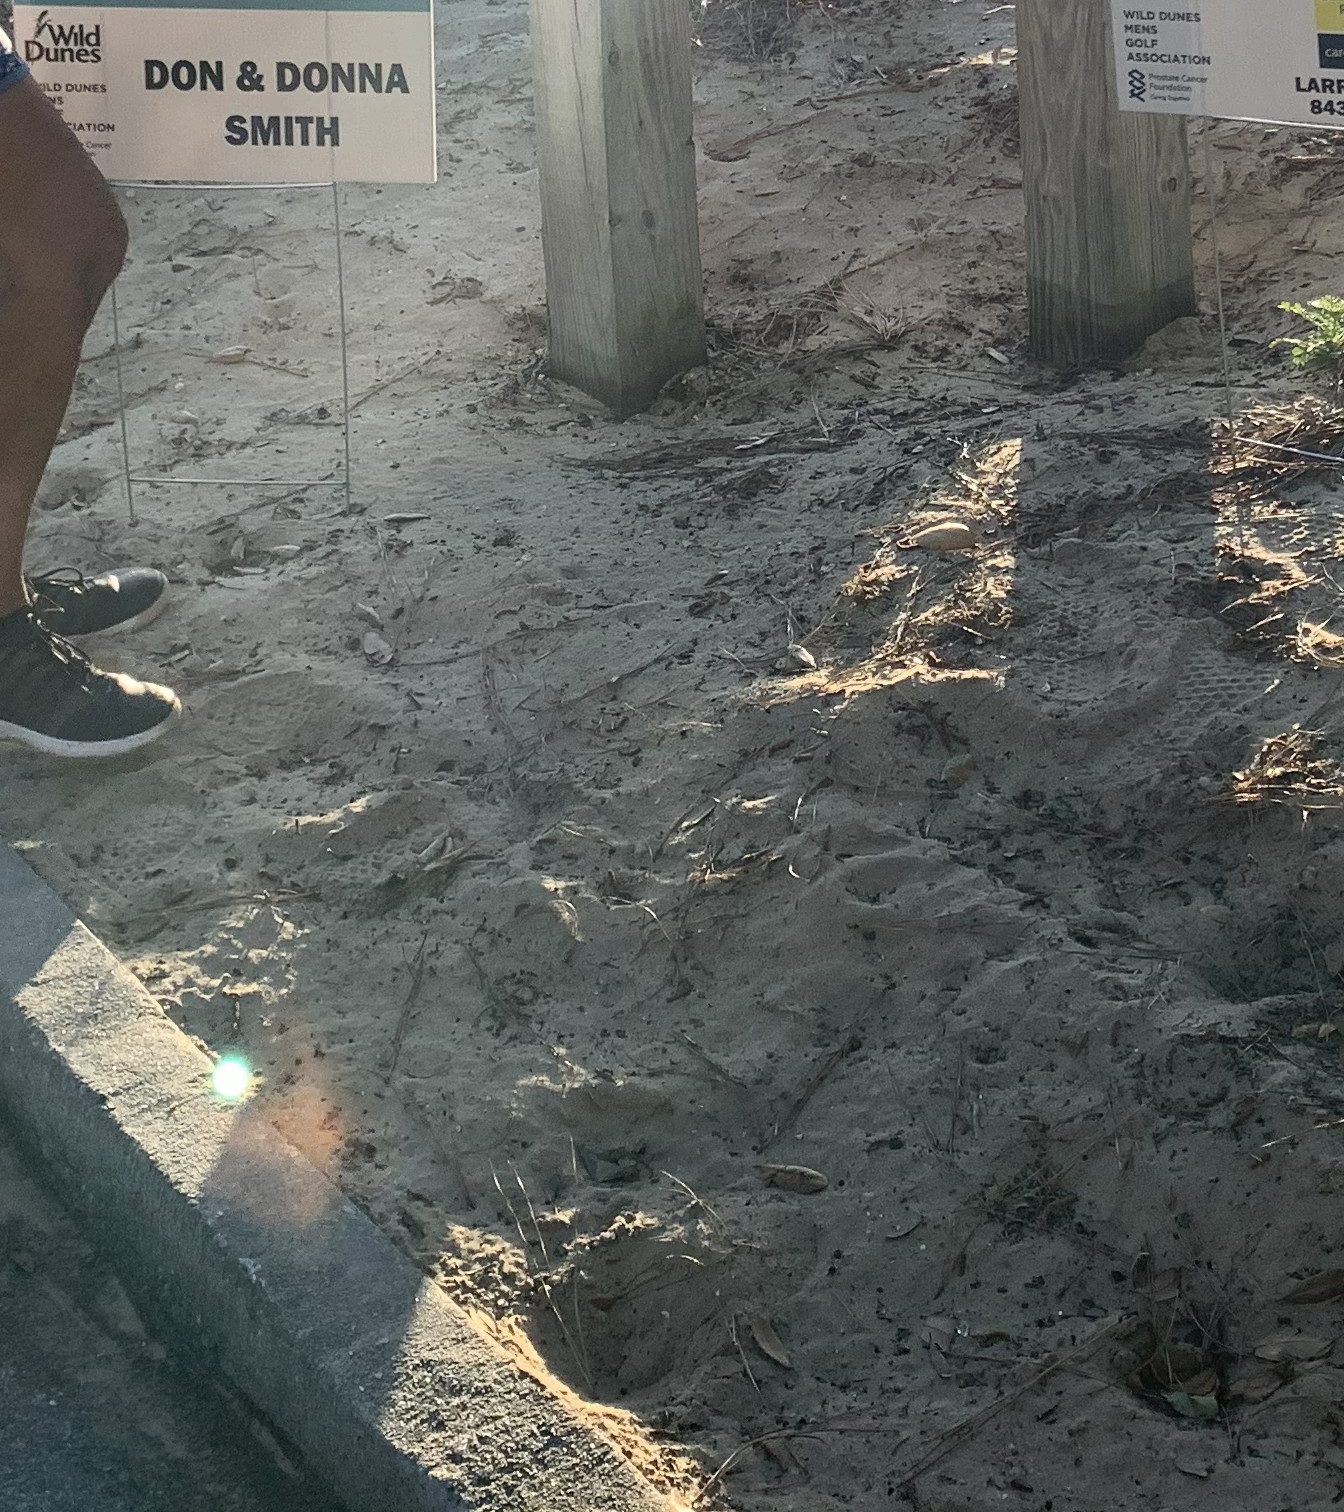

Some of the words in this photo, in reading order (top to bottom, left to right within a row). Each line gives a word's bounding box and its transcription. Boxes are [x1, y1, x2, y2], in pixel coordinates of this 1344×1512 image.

[1123, 10, 1155, 20] WILD
[1159, 11, 1201, 23] DUNES
[46, 22, 101, 48] Wild
[1124, 24, 1158, 35] MENS
[1125, 38, 1158, 48] GOLF
[25, 40, 102, 64] Dunes
[1126, 52, 1211, 66] ASSOCIATION
[144, 59, 223, 92] DON
[236, 60, 265, 92] &
[276, 61, 410, 94] DONNA
[39, 83, 62, 92] ILD
[65, 83, 107, 93] DUNES
[224, 115, 340, 148] SMITH
